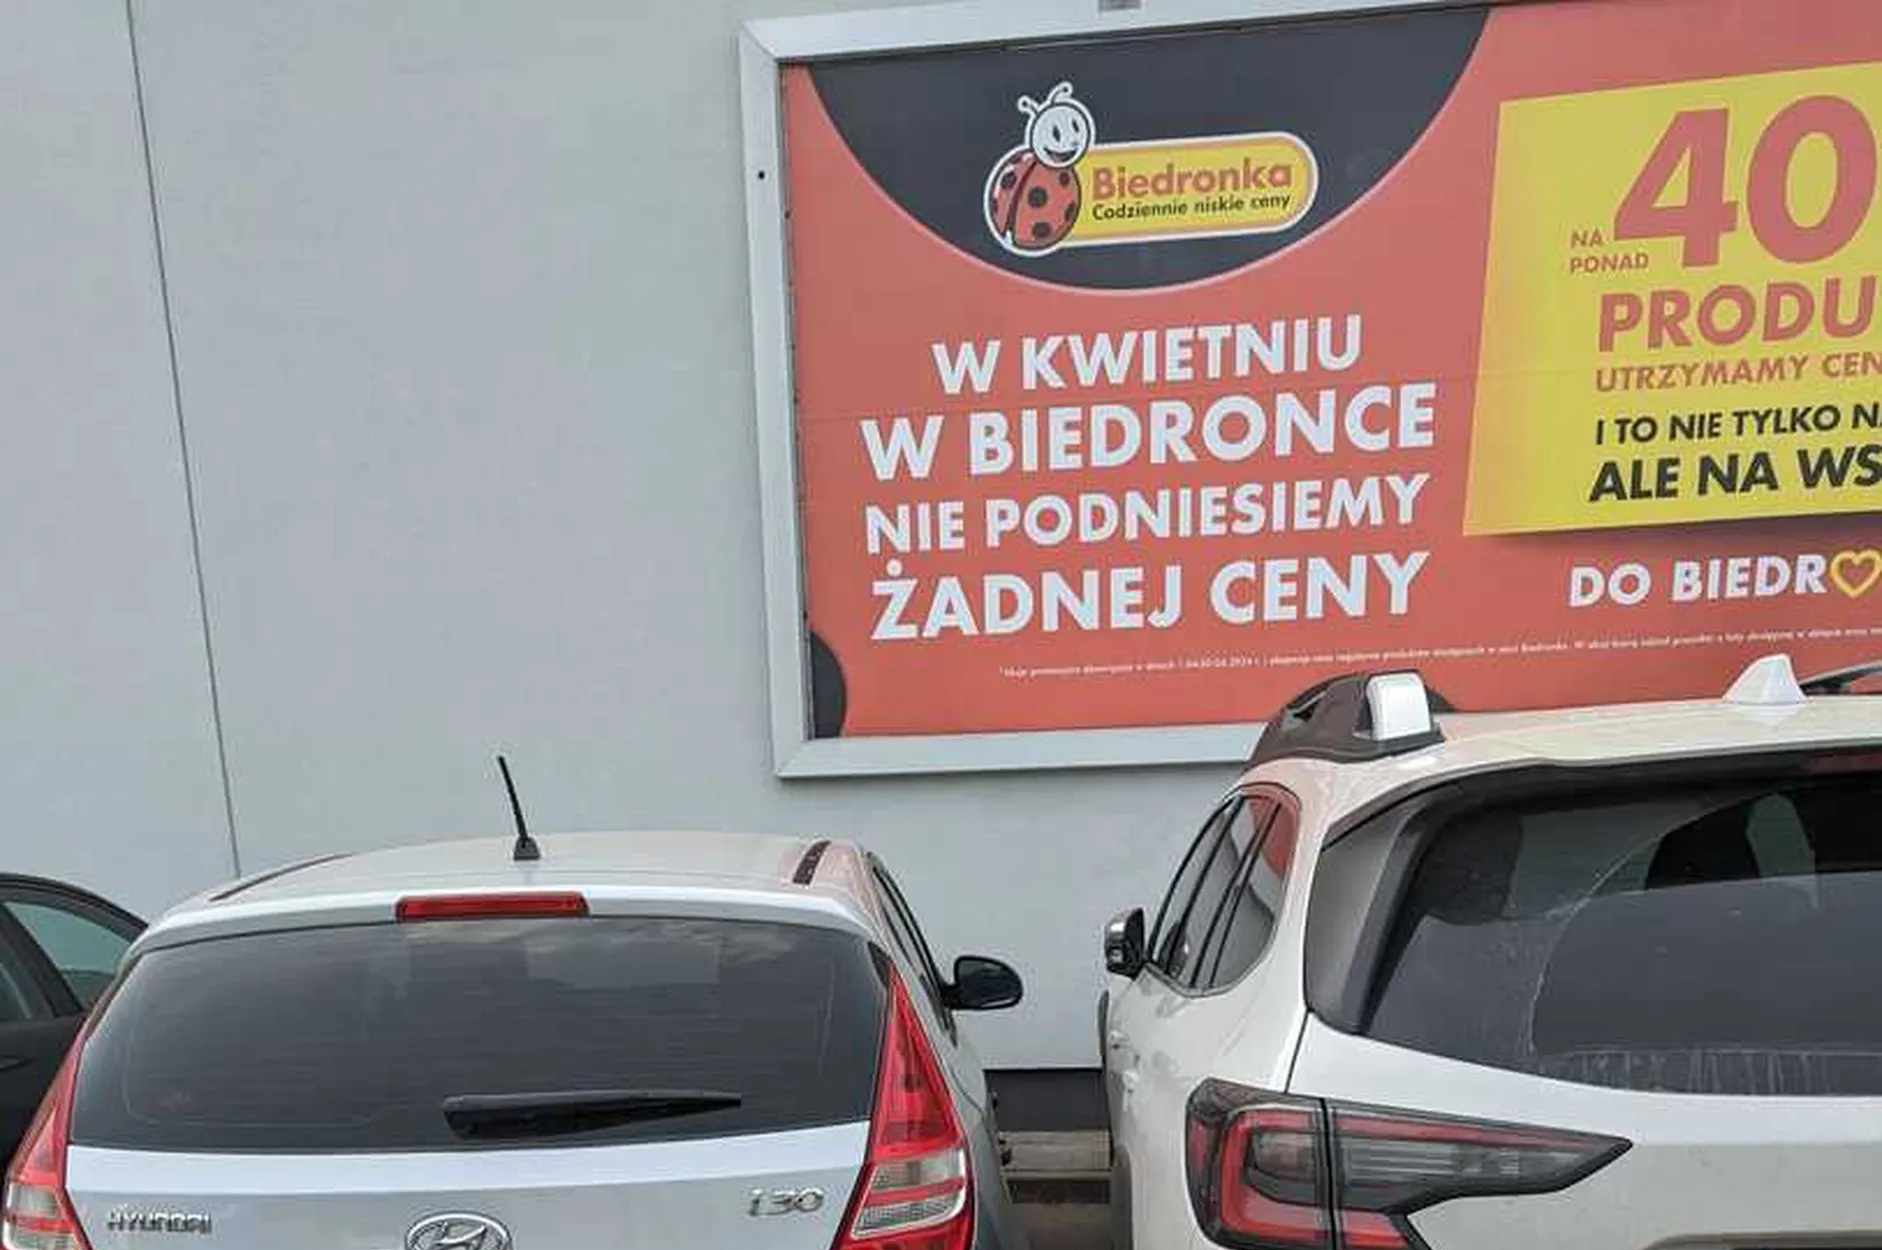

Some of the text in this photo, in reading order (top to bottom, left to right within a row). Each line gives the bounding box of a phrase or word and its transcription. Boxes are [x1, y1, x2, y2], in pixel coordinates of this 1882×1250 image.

[1092, 156, 1292, 199] Biedronka
[1092, 191, 1291, 222] Codziennie niskie ceny
[1570, 229, 1605, 249] NA
[1569, 252, 1649, 274] PONAD
[1598, 275, 1878, 353] PRODU
[932, 314, 1362, 395] W KWIETNIU
[1596, 355, 1809, 393] UTRZYMAMY
[861, 383, 1438, 482] W BIEDRONCE
[1595, 401, 1882, 446] I TO NIE TYLKO N
[1588, 443, 1882, 503] ALE NA WS
[865, 473, 1432, 556] NIE PODNIESIEMY
[870, 550, 1431, 642] ŻADNEJ CENY
[1569, 563, 1652, 608] DO
[107, 1209, 214, 1235] HYUNDAI
